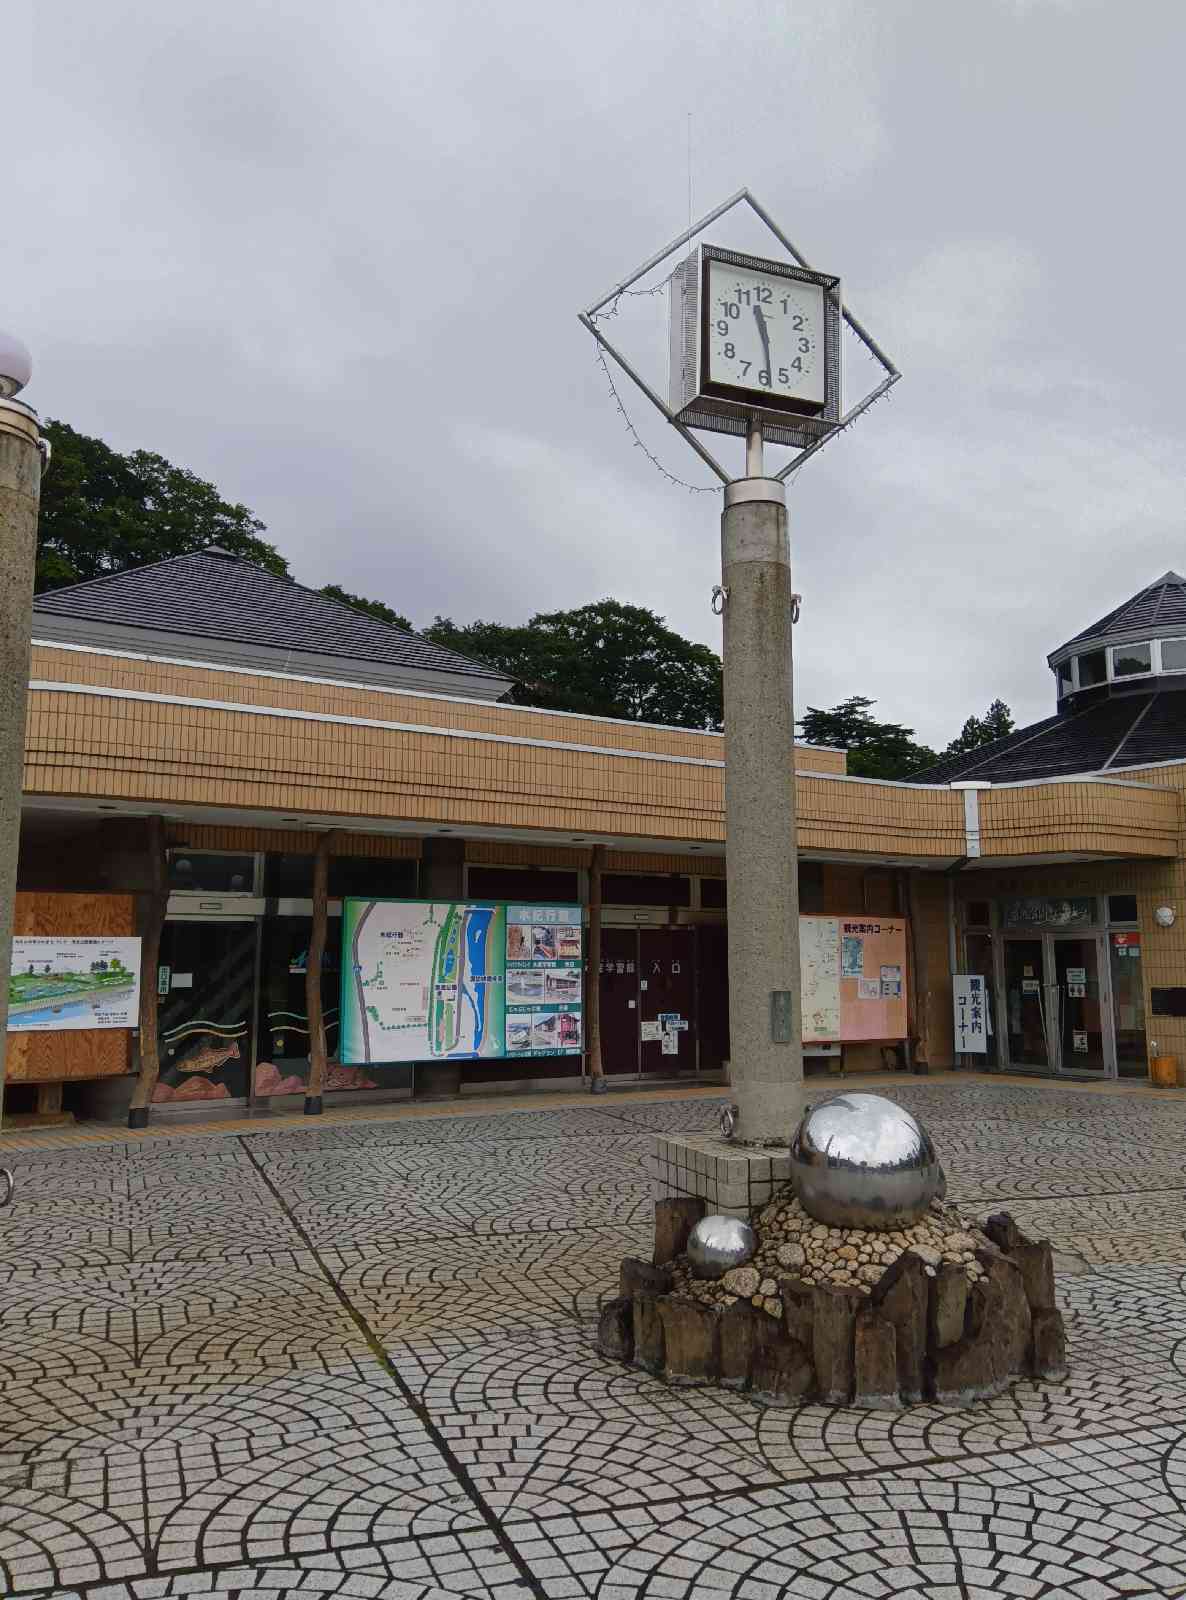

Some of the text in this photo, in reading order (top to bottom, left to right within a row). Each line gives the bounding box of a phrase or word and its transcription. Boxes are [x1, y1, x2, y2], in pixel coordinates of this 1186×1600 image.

[734, 288, 751, 306] 11
[753, 286, 773, 305] 12
[720, 302, 741, 320] 10
[779, 298, 788, 315] 1
[716, 320, 729, 337] 9
[792, 315, 804, 332] 2
[723, 342, 736, 359] 8
[798, 337, 810, 354] 3
[739, 359, 753, 377] 7
[791, 356, 802, 373] 4
[758, 369, 770, 386] 6
[778, 367, 790, 384] 5
[843, 923, 903, 935] 観光案内コーナー
[968, 978, 982, 1034] 観光案内
[958, 996, 969, 1049] コーナー
